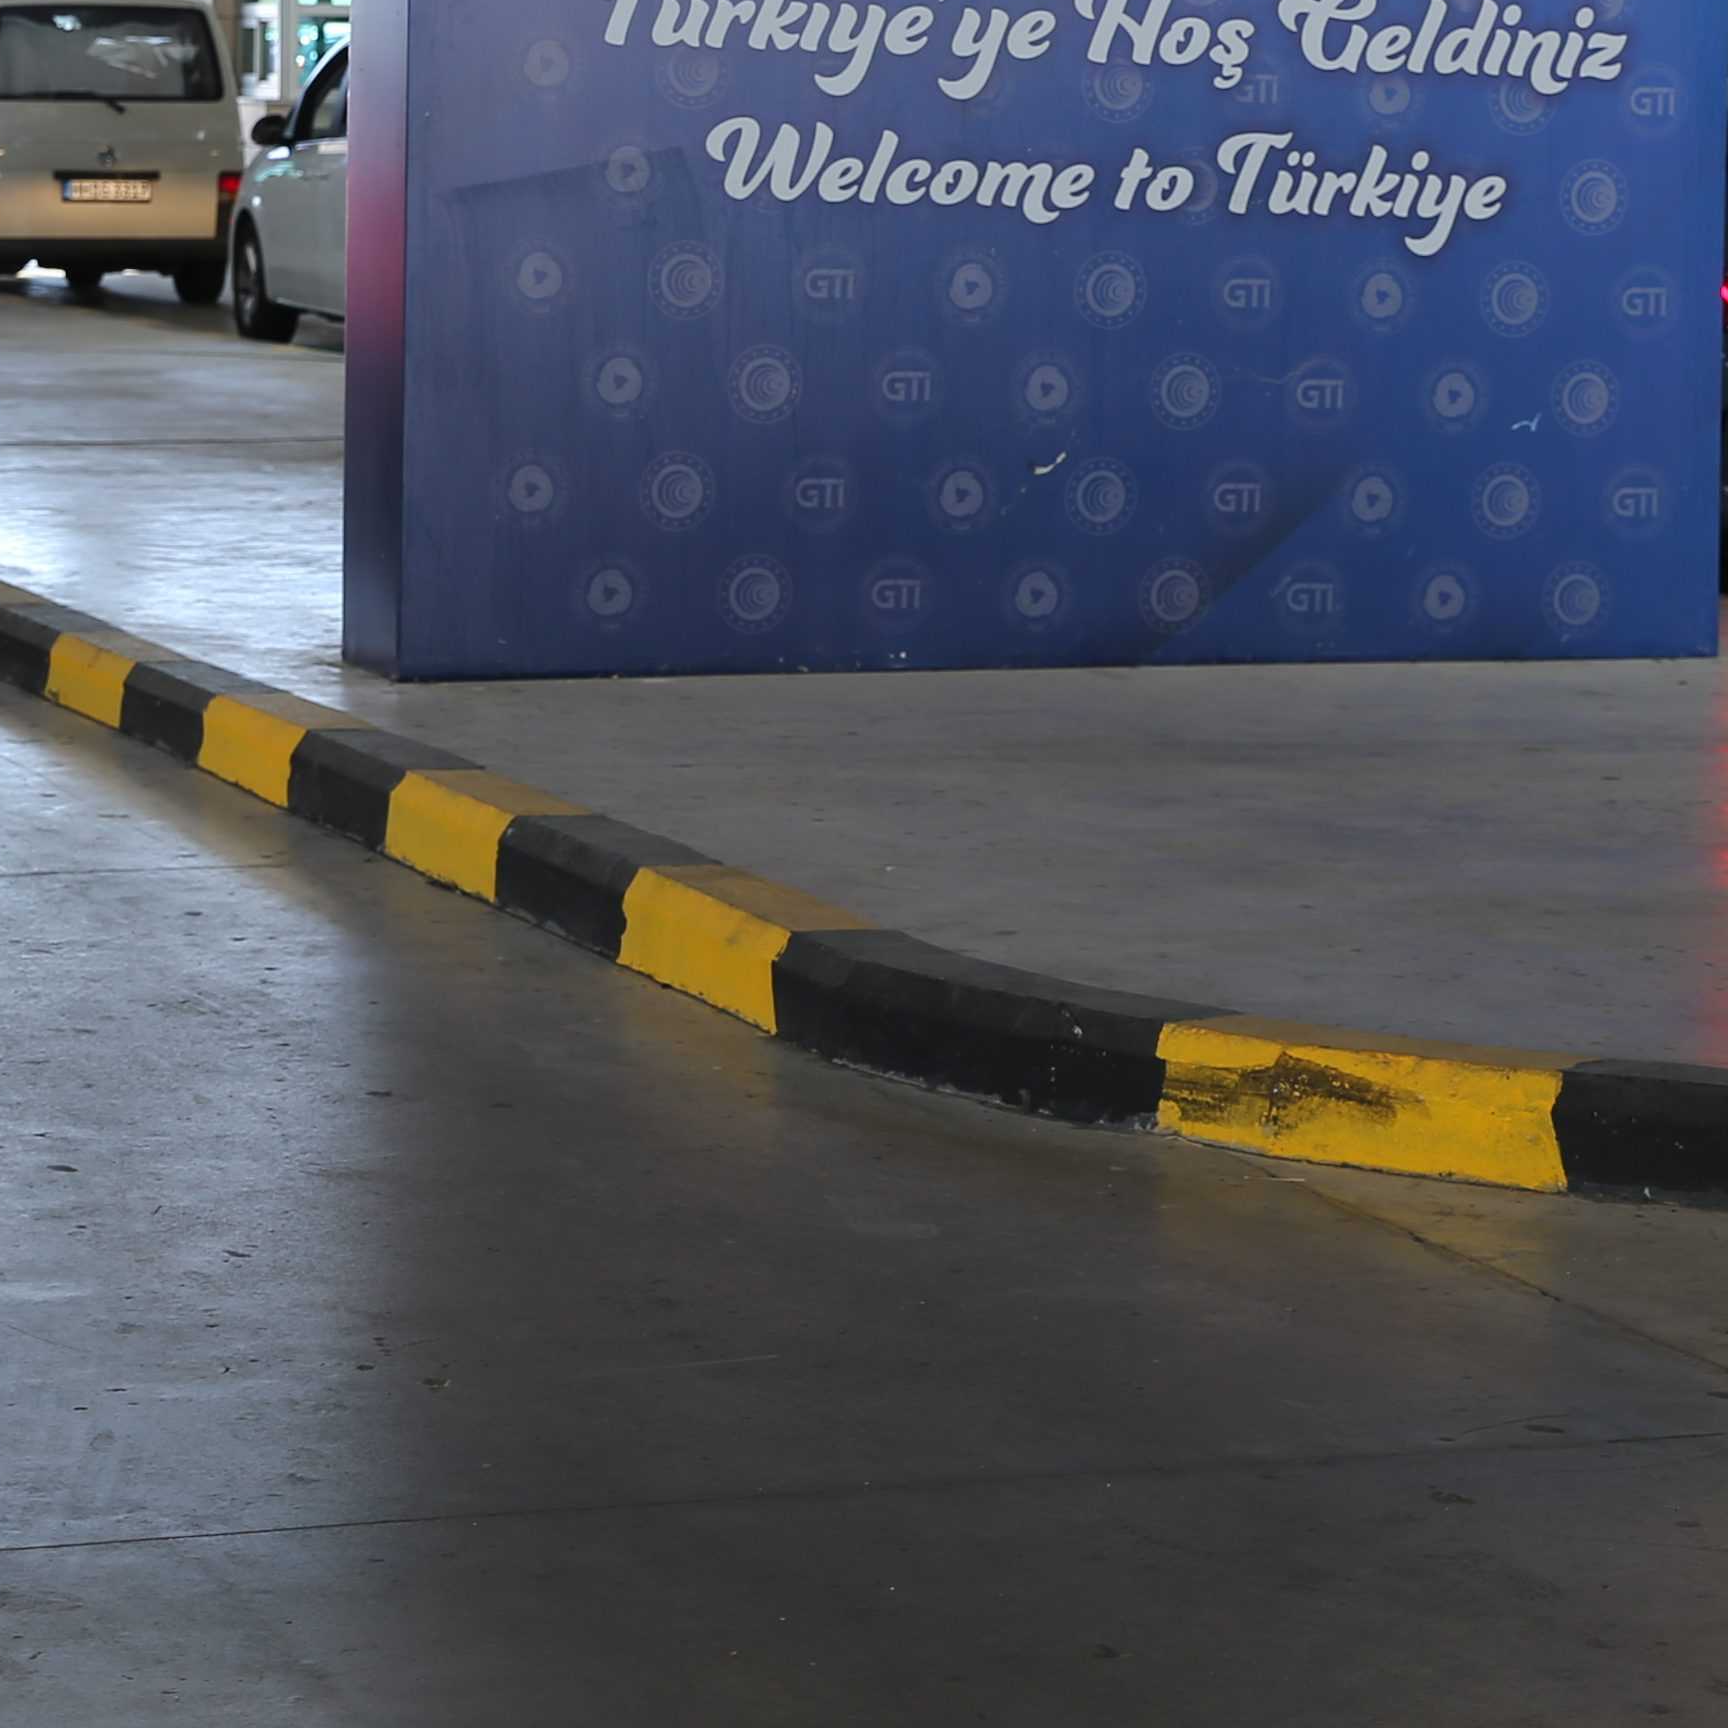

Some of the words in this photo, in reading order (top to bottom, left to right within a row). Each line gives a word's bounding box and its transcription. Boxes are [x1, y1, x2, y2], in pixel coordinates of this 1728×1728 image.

[705, 116, 1095, 224] Welcome
[1114, 148, 1194, 212] to
[1216, 131, 1507, 257] Türkiye
